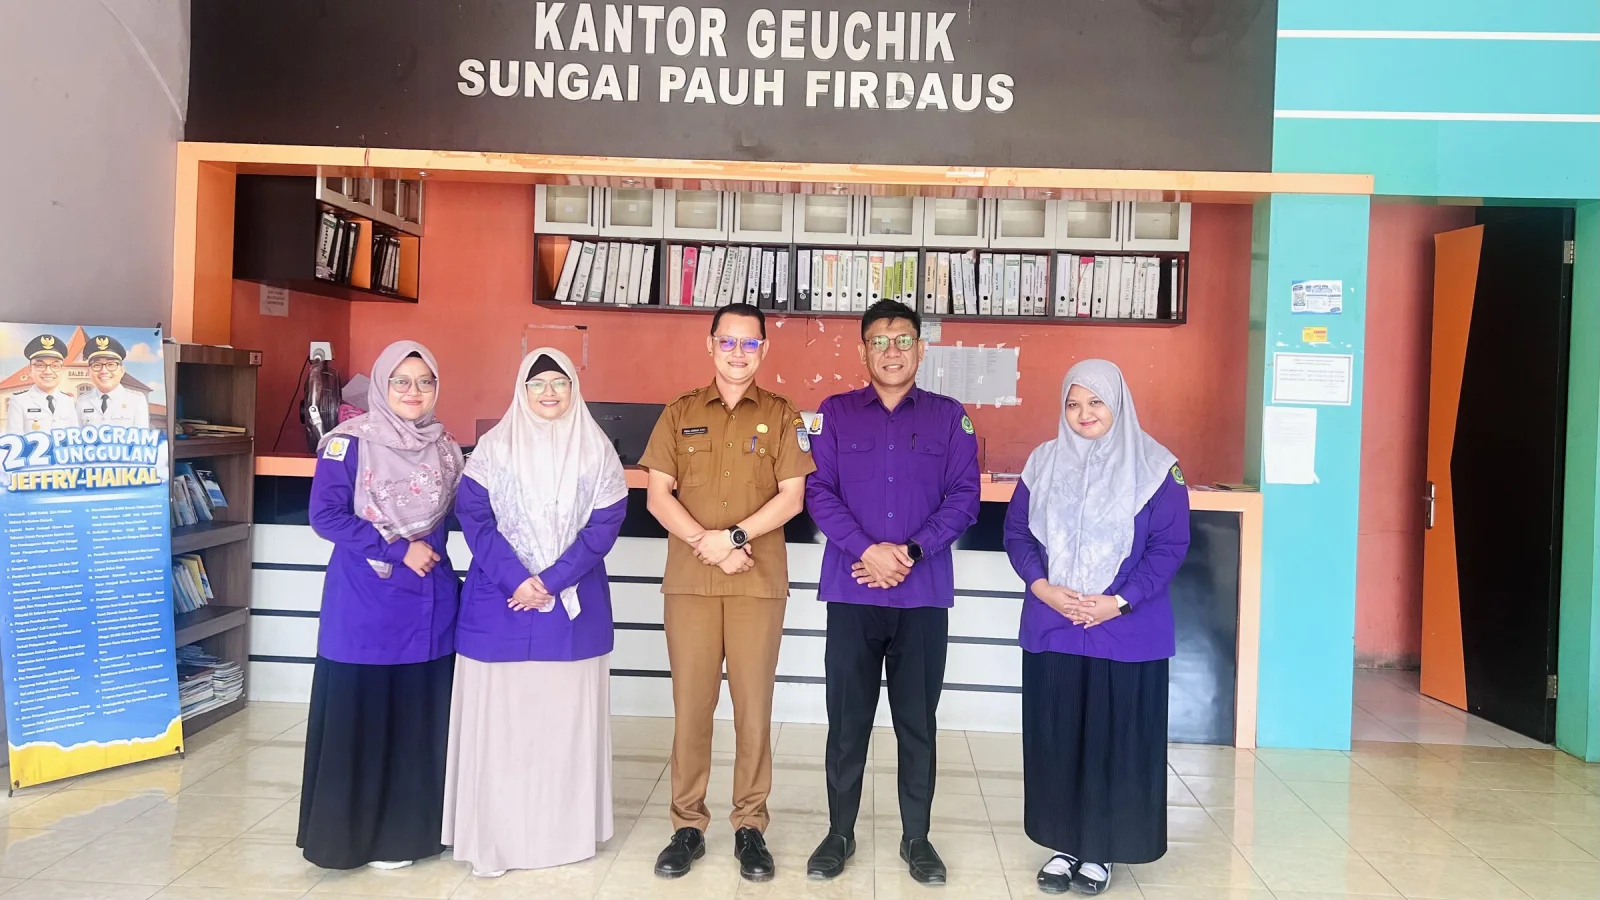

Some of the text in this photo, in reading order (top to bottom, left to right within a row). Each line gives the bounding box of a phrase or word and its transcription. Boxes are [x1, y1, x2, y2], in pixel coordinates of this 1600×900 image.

[535, 2, 956, 62] KANTOR GEUCHIK
[457, 58, 1015, 112] SUNGAI PAUH FIRDAUS
[0, 425, 160, 471] 22 PROGRAM
[54, 446, 158, 465] UNGGULAN
[9, 467, 162, 491] JEFFRY-HAIKAL
